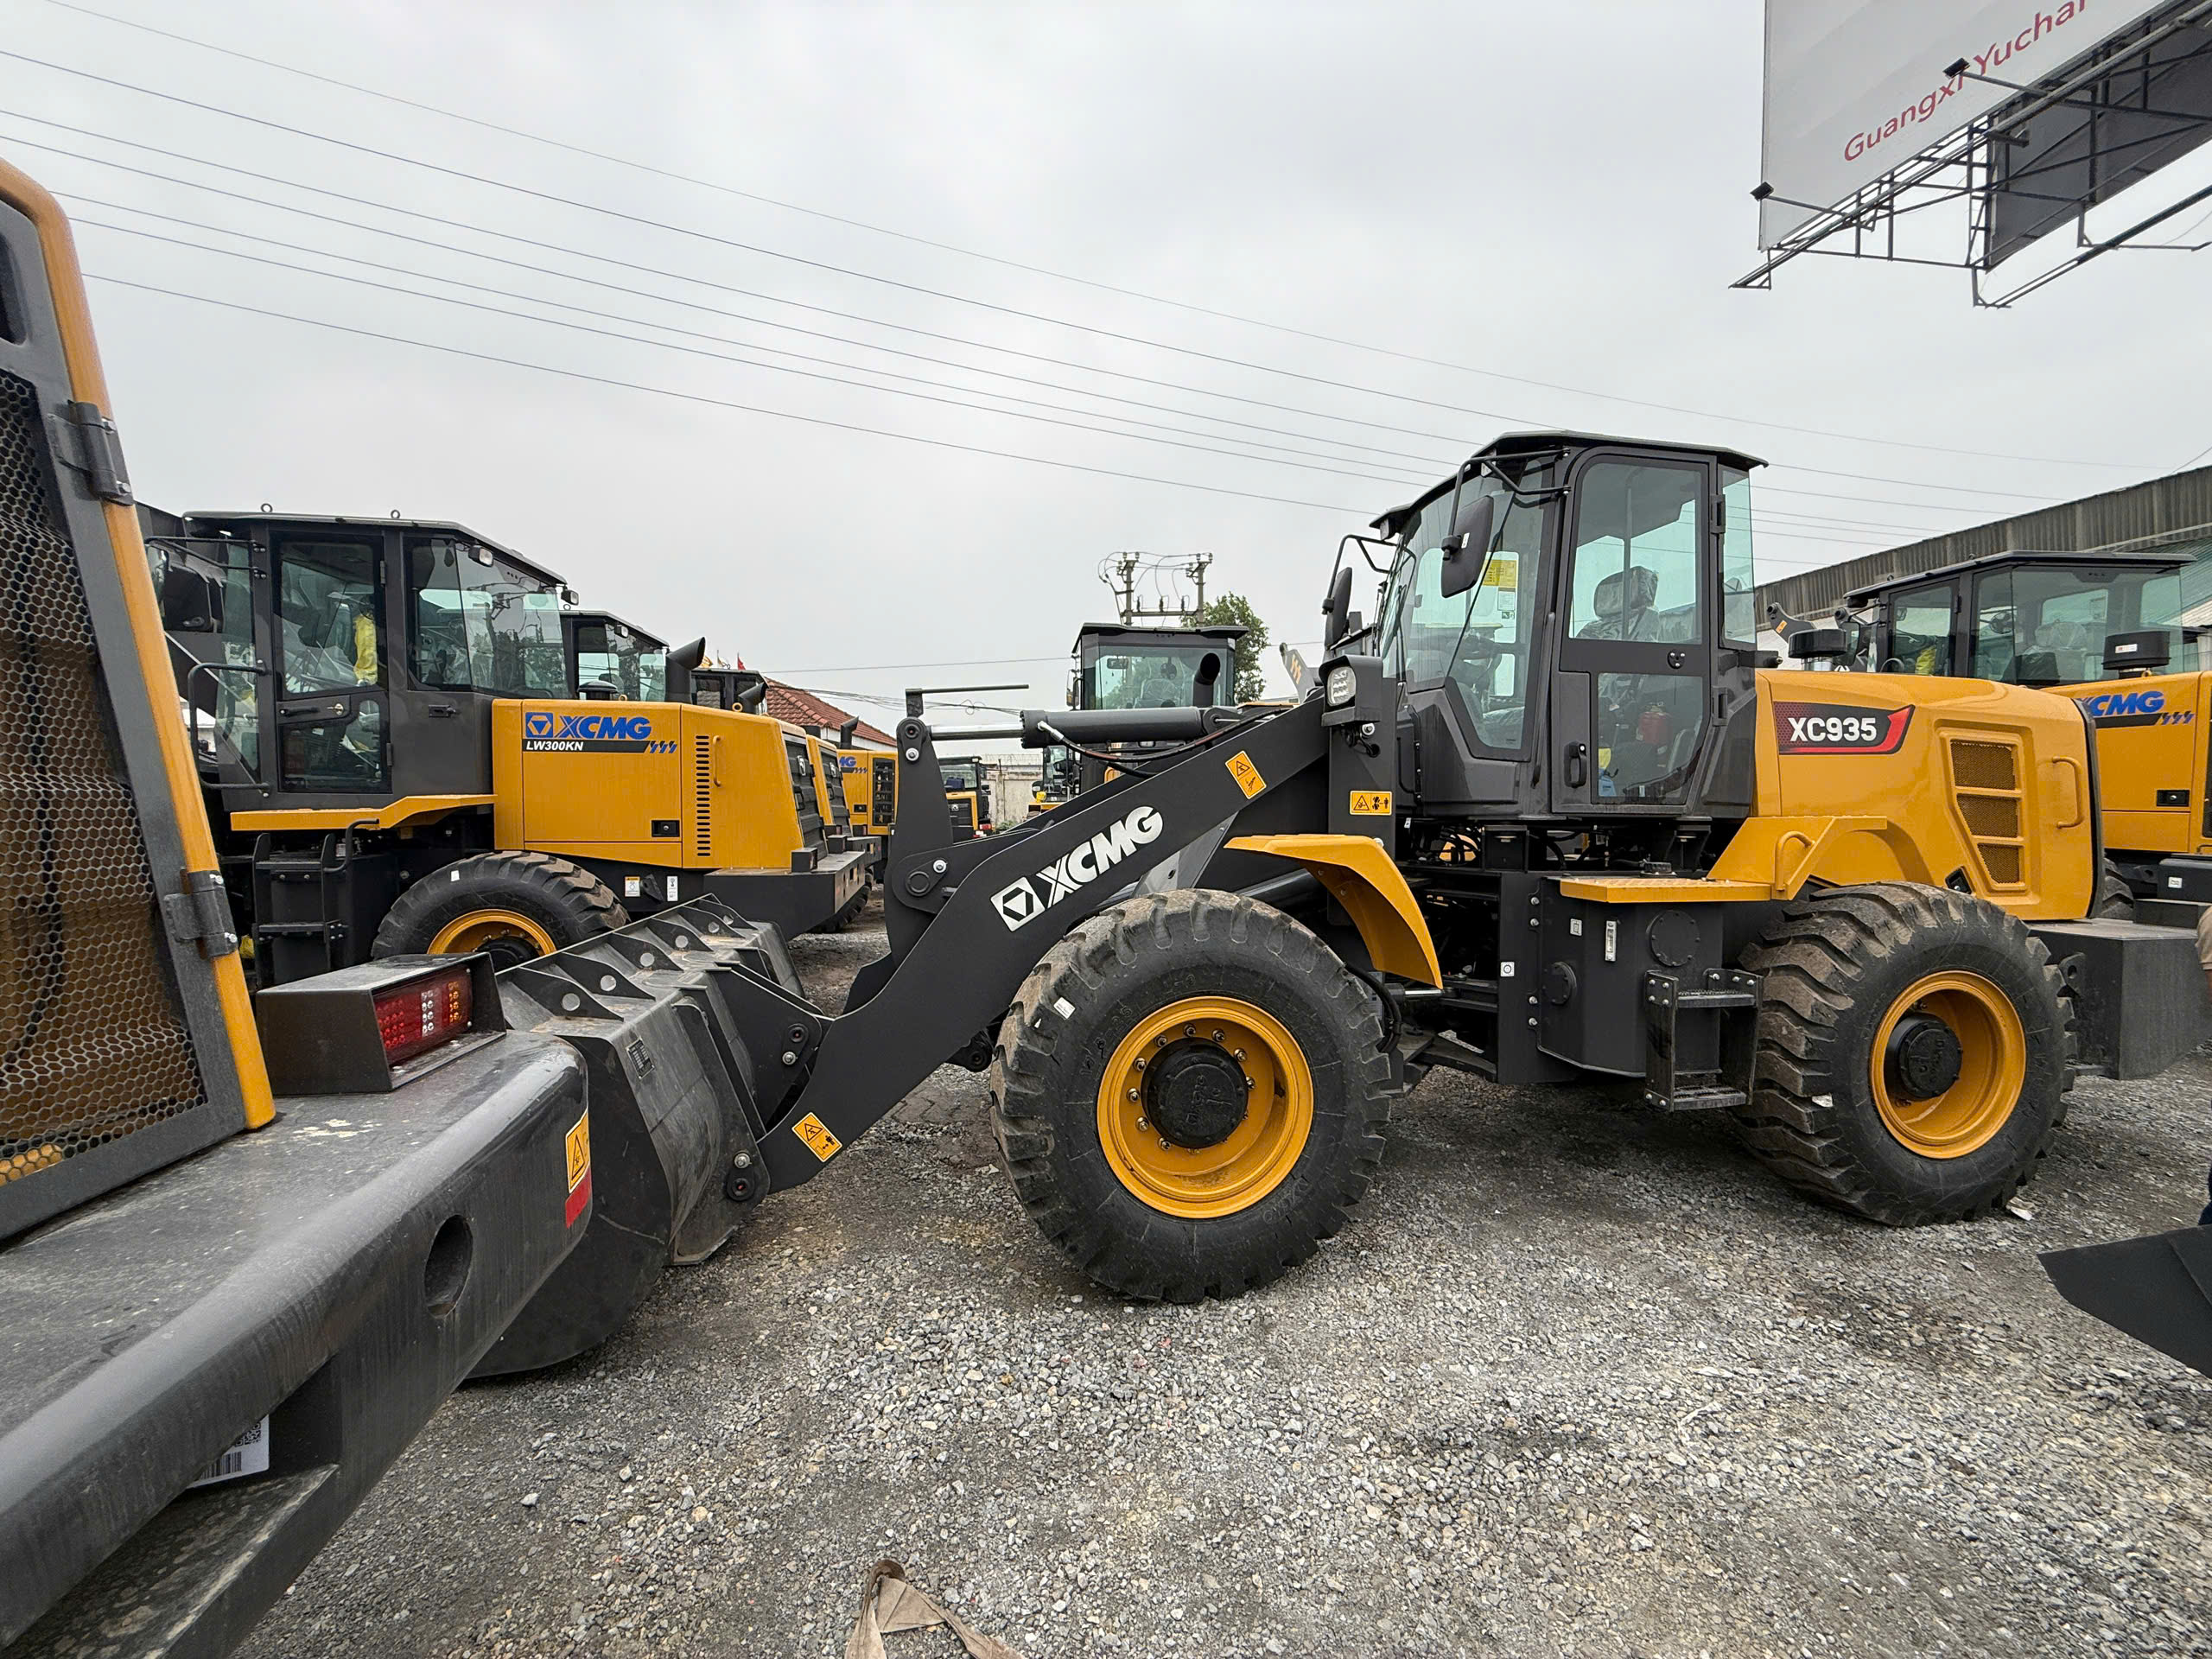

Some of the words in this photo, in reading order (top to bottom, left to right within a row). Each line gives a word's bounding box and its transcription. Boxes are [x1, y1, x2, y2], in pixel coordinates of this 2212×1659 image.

[1844, 74, 1964, 162] Guangxi
[554, 715, 652, 740] XCMG
[1788, 717, 1878, 742] XC935
[526, 741, 584, 752] LW300KN
[1035, 805, 1164, 909] XCMG
